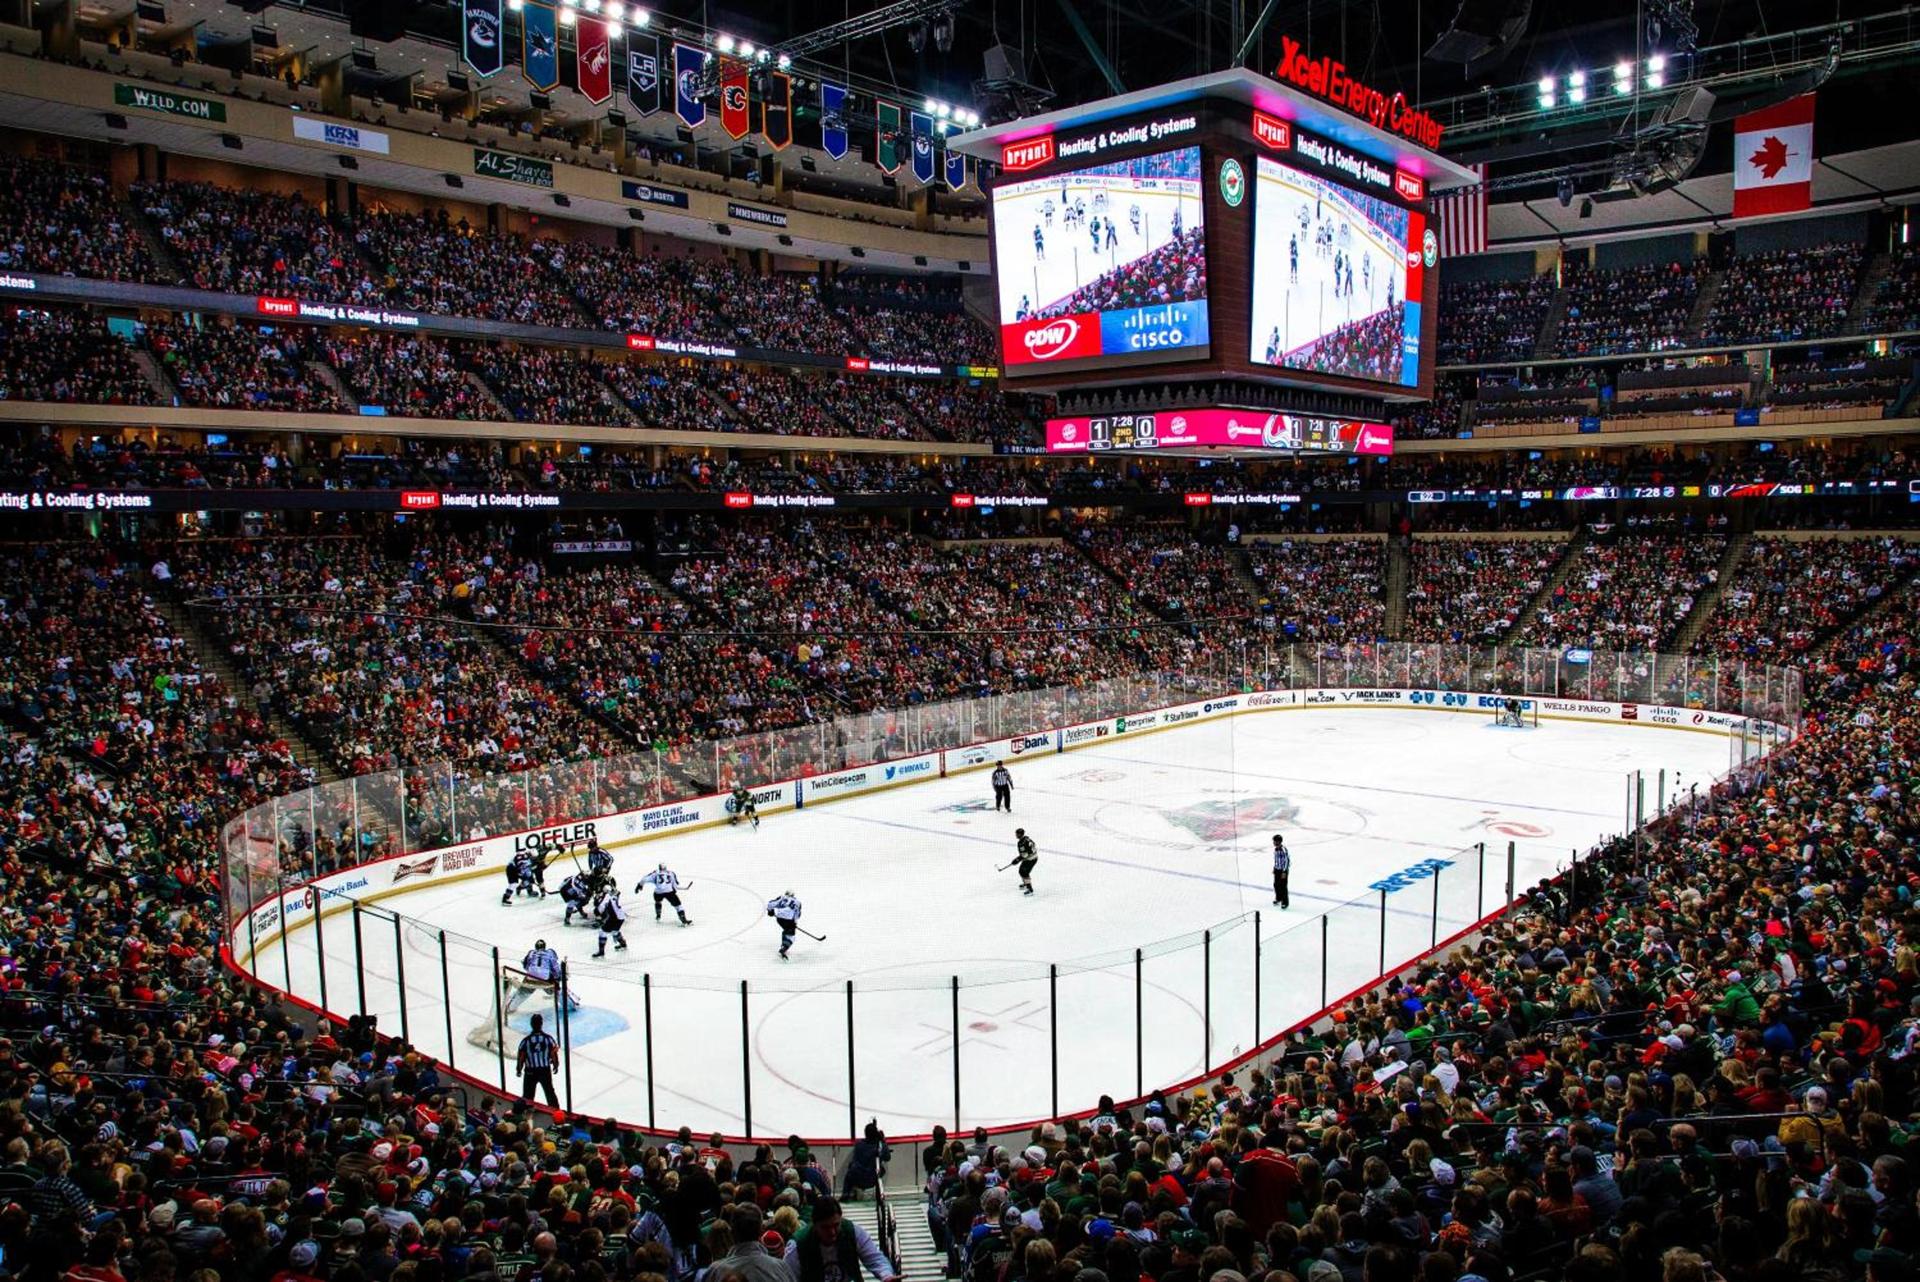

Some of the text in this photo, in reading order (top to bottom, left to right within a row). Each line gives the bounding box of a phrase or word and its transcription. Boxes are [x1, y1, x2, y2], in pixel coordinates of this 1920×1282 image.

[633, 56, 656, 73] LA
[1277, 35, 1446, 151] Xcel Energy Center
[134, 88, 210, 119] WILD.COM
[1006, 117, 1197, 166] bryant Heating & Cooling Systems
[1258, 119, 1391, 188] bryant Heating & Cooling Systems
[1398, 176, 1420, 197] bryant
[0, 276, 36, 290] stems
[264, 301, 420, 327] bryant Heating & Cooling Systems
[1024, 327, 1066, 348] CDW
[1131, 329, 1183, 349] CISCO
[654, 339, 680, 353] Heating
[680, 342, 687, 354] &
[687, 343, 710, 357] Cooling
[710, 345, 737, 358] Systems
[1112, 416, 1134, 427] 7:28
[1140, 419, 1152, 437] 0
[1094, 422, 1102, 440] 1
[1116, 428, 1133, 437] 2ND
[1522, 490, 1542, 499] SOG
[1634, 488, 1661, 498] 7:28
[1779, 484, 1802, 494] SOG
[31, 493, 43, 507] &
[46, 493, 95, 509] Cooling
[96, 493, 152, 509] Systems
[407, 494, 560, 508] bryant Heating & Cooling Systems
[753, 494, 778, 506] Heating
[785, 495, 809, 507] Cooling
[809, 495, 836, 507] Systems
[1212, 493, 1238, 505] Heating
[1245, 493, 1271, 505] Cooling
[1271, 494, 1301, 506] Systems
[1356, 690, 1375, 699] JACK
[1478, 695, 1532, 710] ECOB
[1213, 699, 1238, 711] POLARIS
[1543, 701, 1577, 713] WELLS
[1578, 703, 1611, 714] FARGO
[1652, 715, 1678, 724] CISCO
[1707, 715, 1725, 726] Xcel
[1024, 733, 1050, 749] bank
[752, 789, 783, 806] NORTH
[643, 806, 684, 823] MAYO CLINIC
[643, 812, 701, 831] SPORTS MEDICINE
[514, 822, 599, 854] LOFFLER
[443, 845, 485, 864] BREWED THE
[443, 857, 477, 872] HARD WAY
[346, 877, 369, 891] Bank
